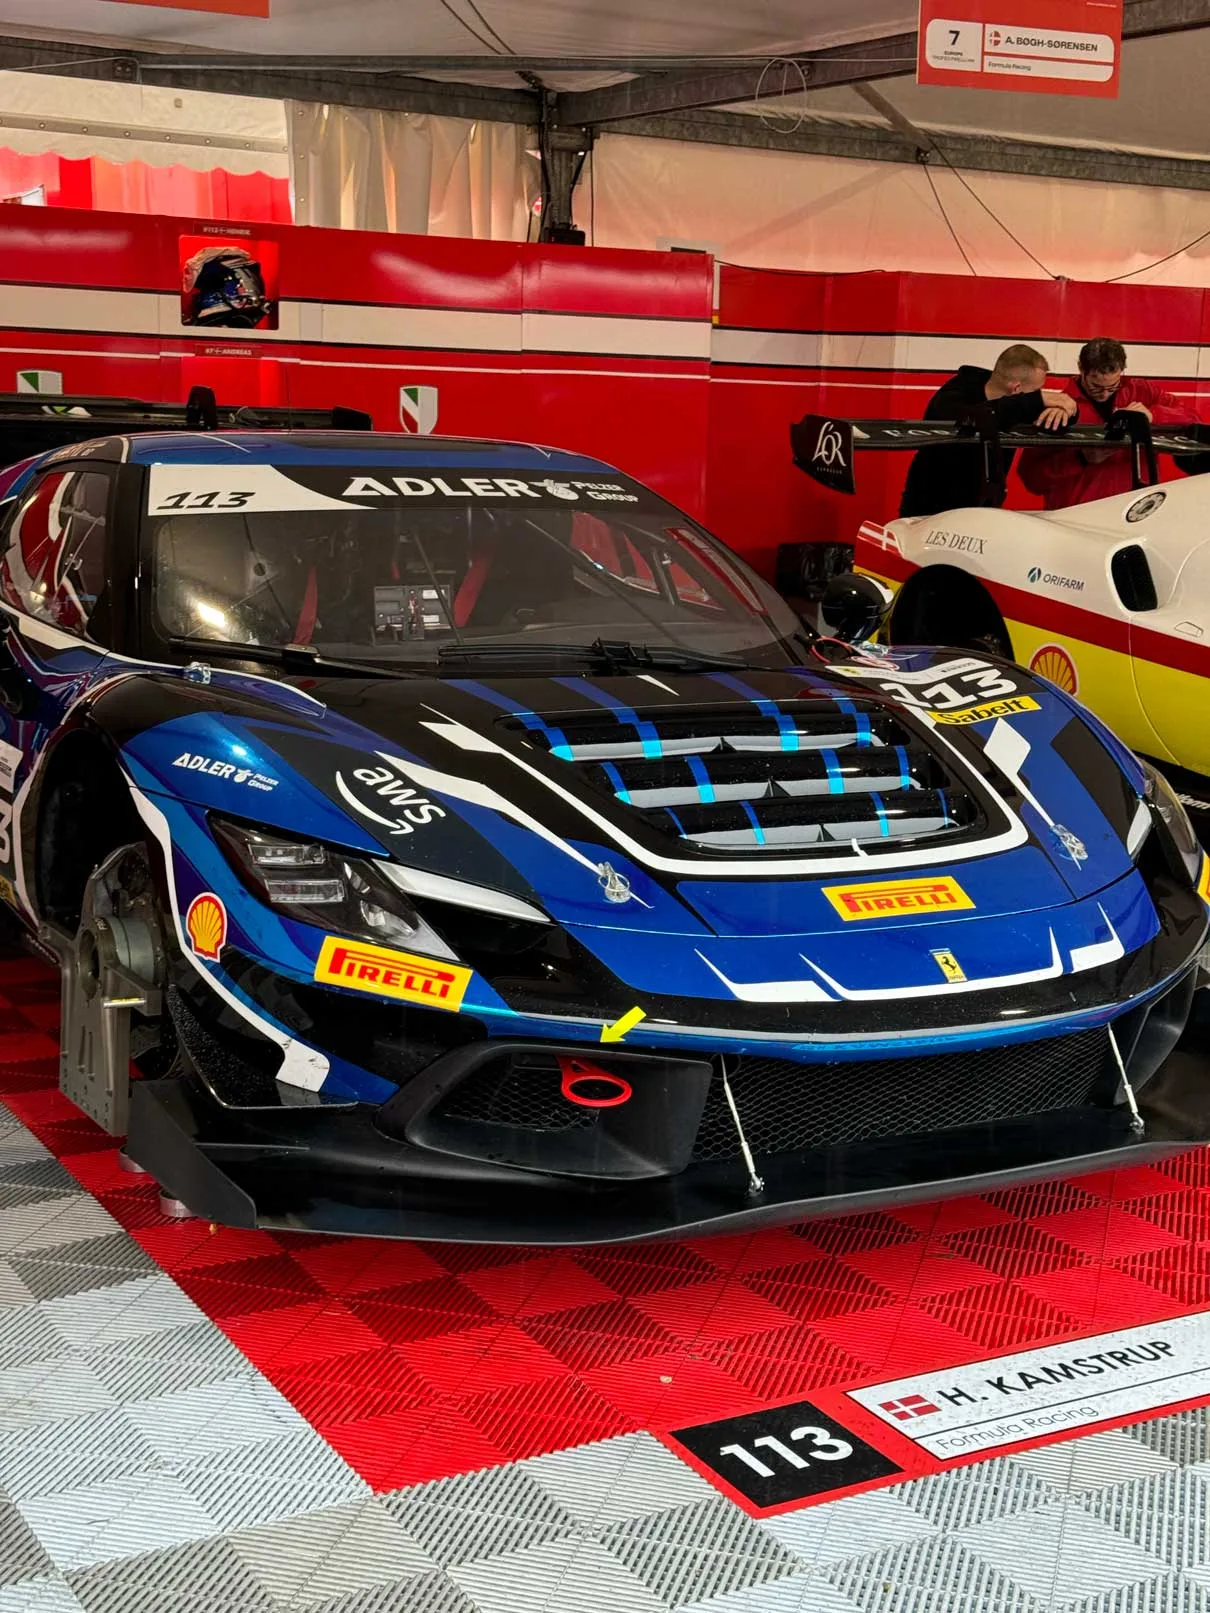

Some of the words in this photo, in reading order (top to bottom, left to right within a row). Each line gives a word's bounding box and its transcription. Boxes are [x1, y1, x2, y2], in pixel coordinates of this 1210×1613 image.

[948, 30, 961, 46] 7
[1004, 36, 1015, 45] A.
[988, 61, 1012, 69] Formula
[1012, 63, 1032, 71] Racing
[341, 477, 543, 498] ADLER
[570, 481, 626, 492] PELZER
[586, 491, 639, 502] GROUP
[156, 491, 256, 510] 113
[924, 530, 949, 546] LES
[949, 533, 988, 555] DEUX
[1042, 574, 1085, 591] ORIFARM
[879, 668, 1017, 709] 113
[938, 699, 1030, 724] Sabelt
[172, 752, 238, 780] ADLER
[352, 765, 447, 825] aws
[838, 884, 958, 913] PIRELLI
[328, 947, 456, 999] PIRELLI
[936, 1386, 989, 1407] H.
[985, 1340, 1176, 1396] KAMSTRUP
[935, 1422, 1024, 1451] Formula
[1022, 1404, 1100, 1429] Racing
[719, 1425, 854, 1478] 113
